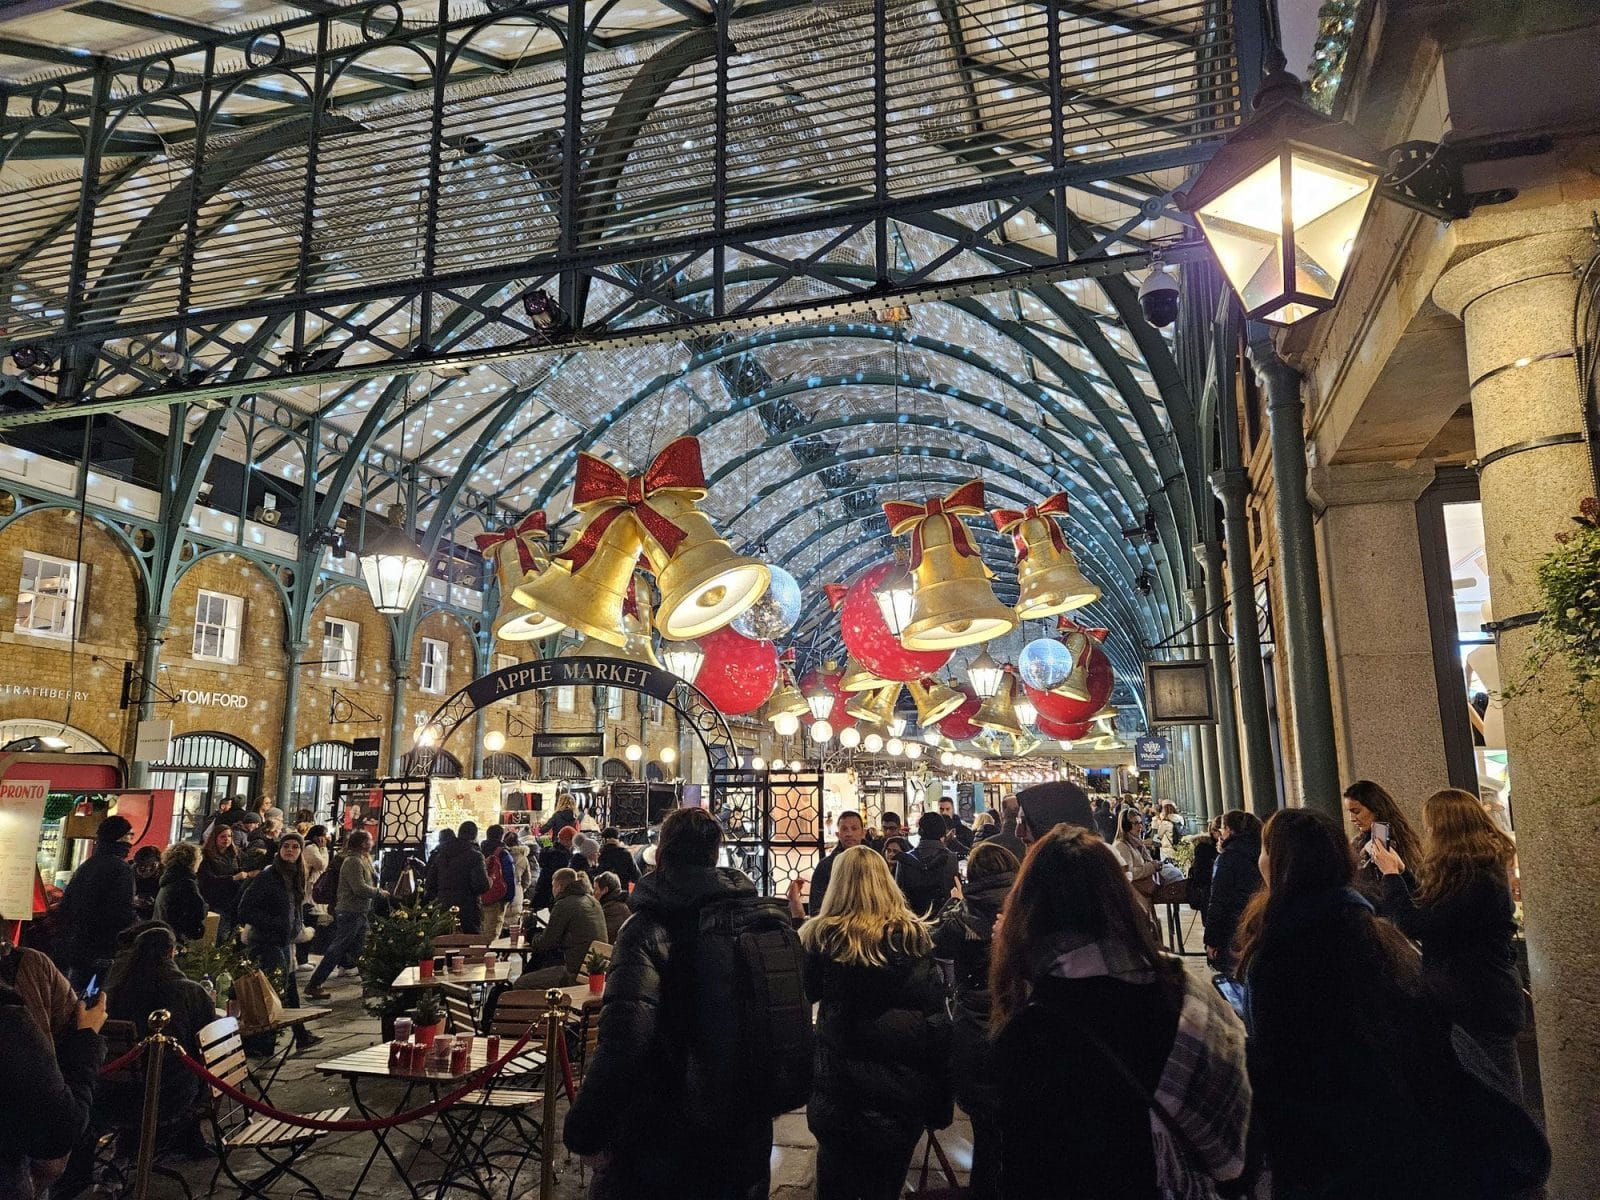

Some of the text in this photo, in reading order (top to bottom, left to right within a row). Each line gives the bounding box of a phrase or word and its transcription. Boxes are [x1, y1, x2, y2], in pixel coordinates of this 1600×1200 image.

[496, 663, 652, 694] APPLE MARKET
[180, 689, 248, 708] TOM FORD
[0, 784, 45, 800] PRONTO
